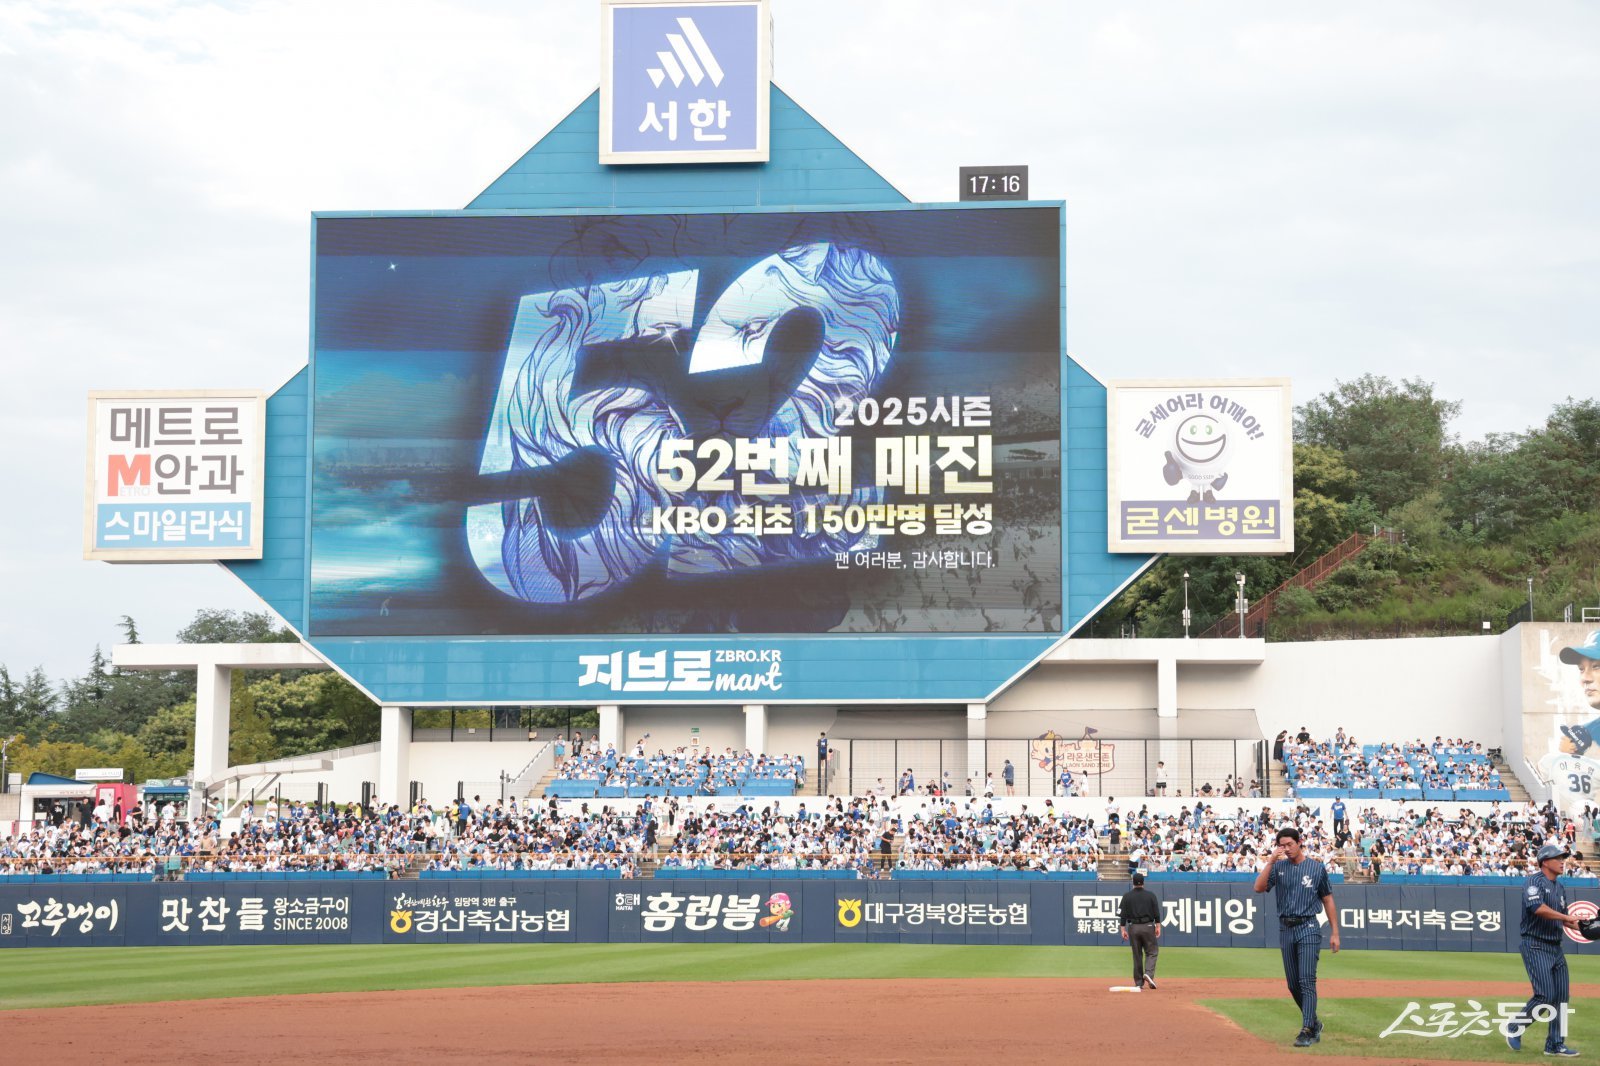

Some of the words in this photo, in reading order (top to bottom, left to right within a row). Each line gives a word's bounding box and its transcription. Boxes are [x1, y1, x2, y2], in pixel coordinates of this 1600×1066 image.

[638, 98, 731, 142] 서한
[969, 175, 1021, 194] 17:16
[834, 396, 993, 427] 2025시즌
[1135, 393, 1204, 439] 굳세어라
[1209, 395, 1264, 441] 어깨야!
[110, 407, 243, 448] 메트로
[154, 453, 245, 495] 안과
[657, 436, 853, 496] 52번째
[875, 435, 993, 495] 매진
[103, 509, 243, 542] 스마일라식
[653, 506, 727, 536] KBO
[733, 506, 793, 536] 최초
[805, 503, 926, 536] 150만명
[933, 503, 993, 536] 달성
[835, 552, 850, 569] 팬
[855, 551, 908, 570] 여러분,
[912, 551, 996, 569] 감사합니다.
[578, 649, 714, 692] 지브로
[715, 649, 782, 662] ZBRO.KR
[714, 661, 783, 692] mart
[1567, 773, 1592, 794] 36
[17, 897, 118, 937] 고추냉이
[273, 896, 349, 916] 왕소금구이
[454, 897, 480, 907] 임당역
[482, 897, 496, 907] 3번
[499, 897, 517, 907] 출구
[641, 892, 761, 932] 홈런볼
[864, 902, 1028, 926] 대구경북양돈농협
[1161, 897, 1257, 935] 제비앙
[273, 917, 312, 931] SINCE
[315, 917, 348, 931] 2008
[414, 909, 570, 933] 경산축산농협
[1340, 908, 1501, 932] 대백저축은행
